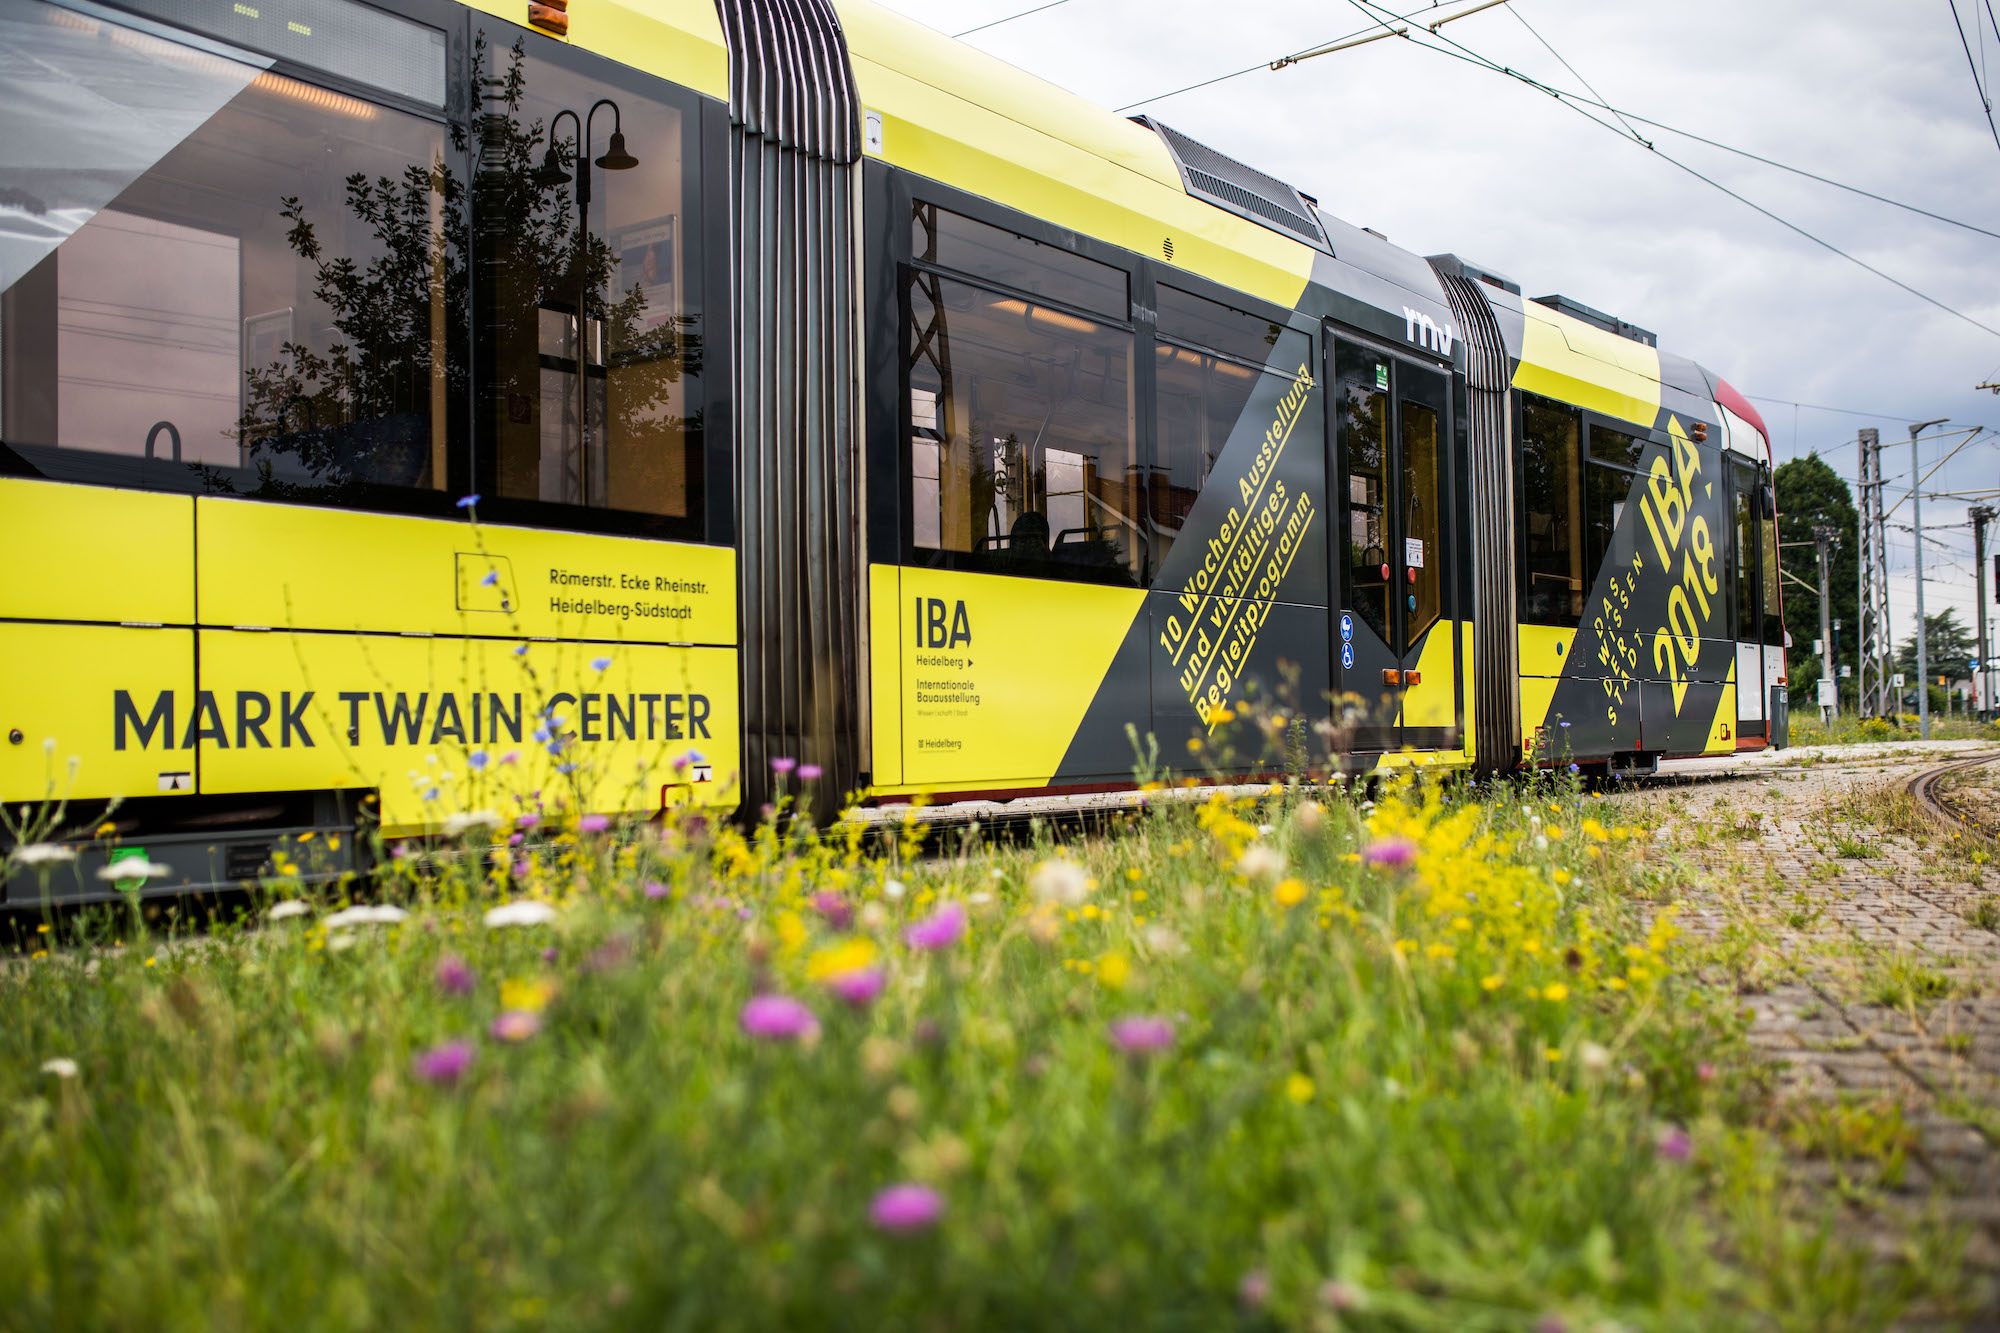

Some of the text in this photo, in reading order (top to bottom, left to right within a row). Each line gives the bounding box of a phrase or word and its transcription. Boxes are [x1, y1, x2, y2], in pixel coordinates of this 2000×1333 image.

[1160, 363, 1314, 656] 10 Wochen Ausstellung
[549, 568, 709, 594] Römerstr. Ecke Rheinstr.
[549, 597, 692, 621] Heidelberg-Südstadt
[1180, 478, 1287, 692] und vielfältiges
[1196, 491, 1311, 727] Begleitprogramm
[1594, 577, 1619, 639] DAS
[1598, 551, 1643, 666] WISSEN
[916, 597, 972, 649] IBA
[1653, 515, 1718, 718] 2018
[916, 655, 964, 670] Heidelberg
[916, 679, 975, 691] Internationale
[1603, 637, 1628, 698] DER
[1607, 628, 1643, 726] STADT
[113, 690, 711, 751] MARK TWAIN CENTER
[916, 691, 980, 706] Bauausstellung
[925, 739, 962, 750] Heidelberg
